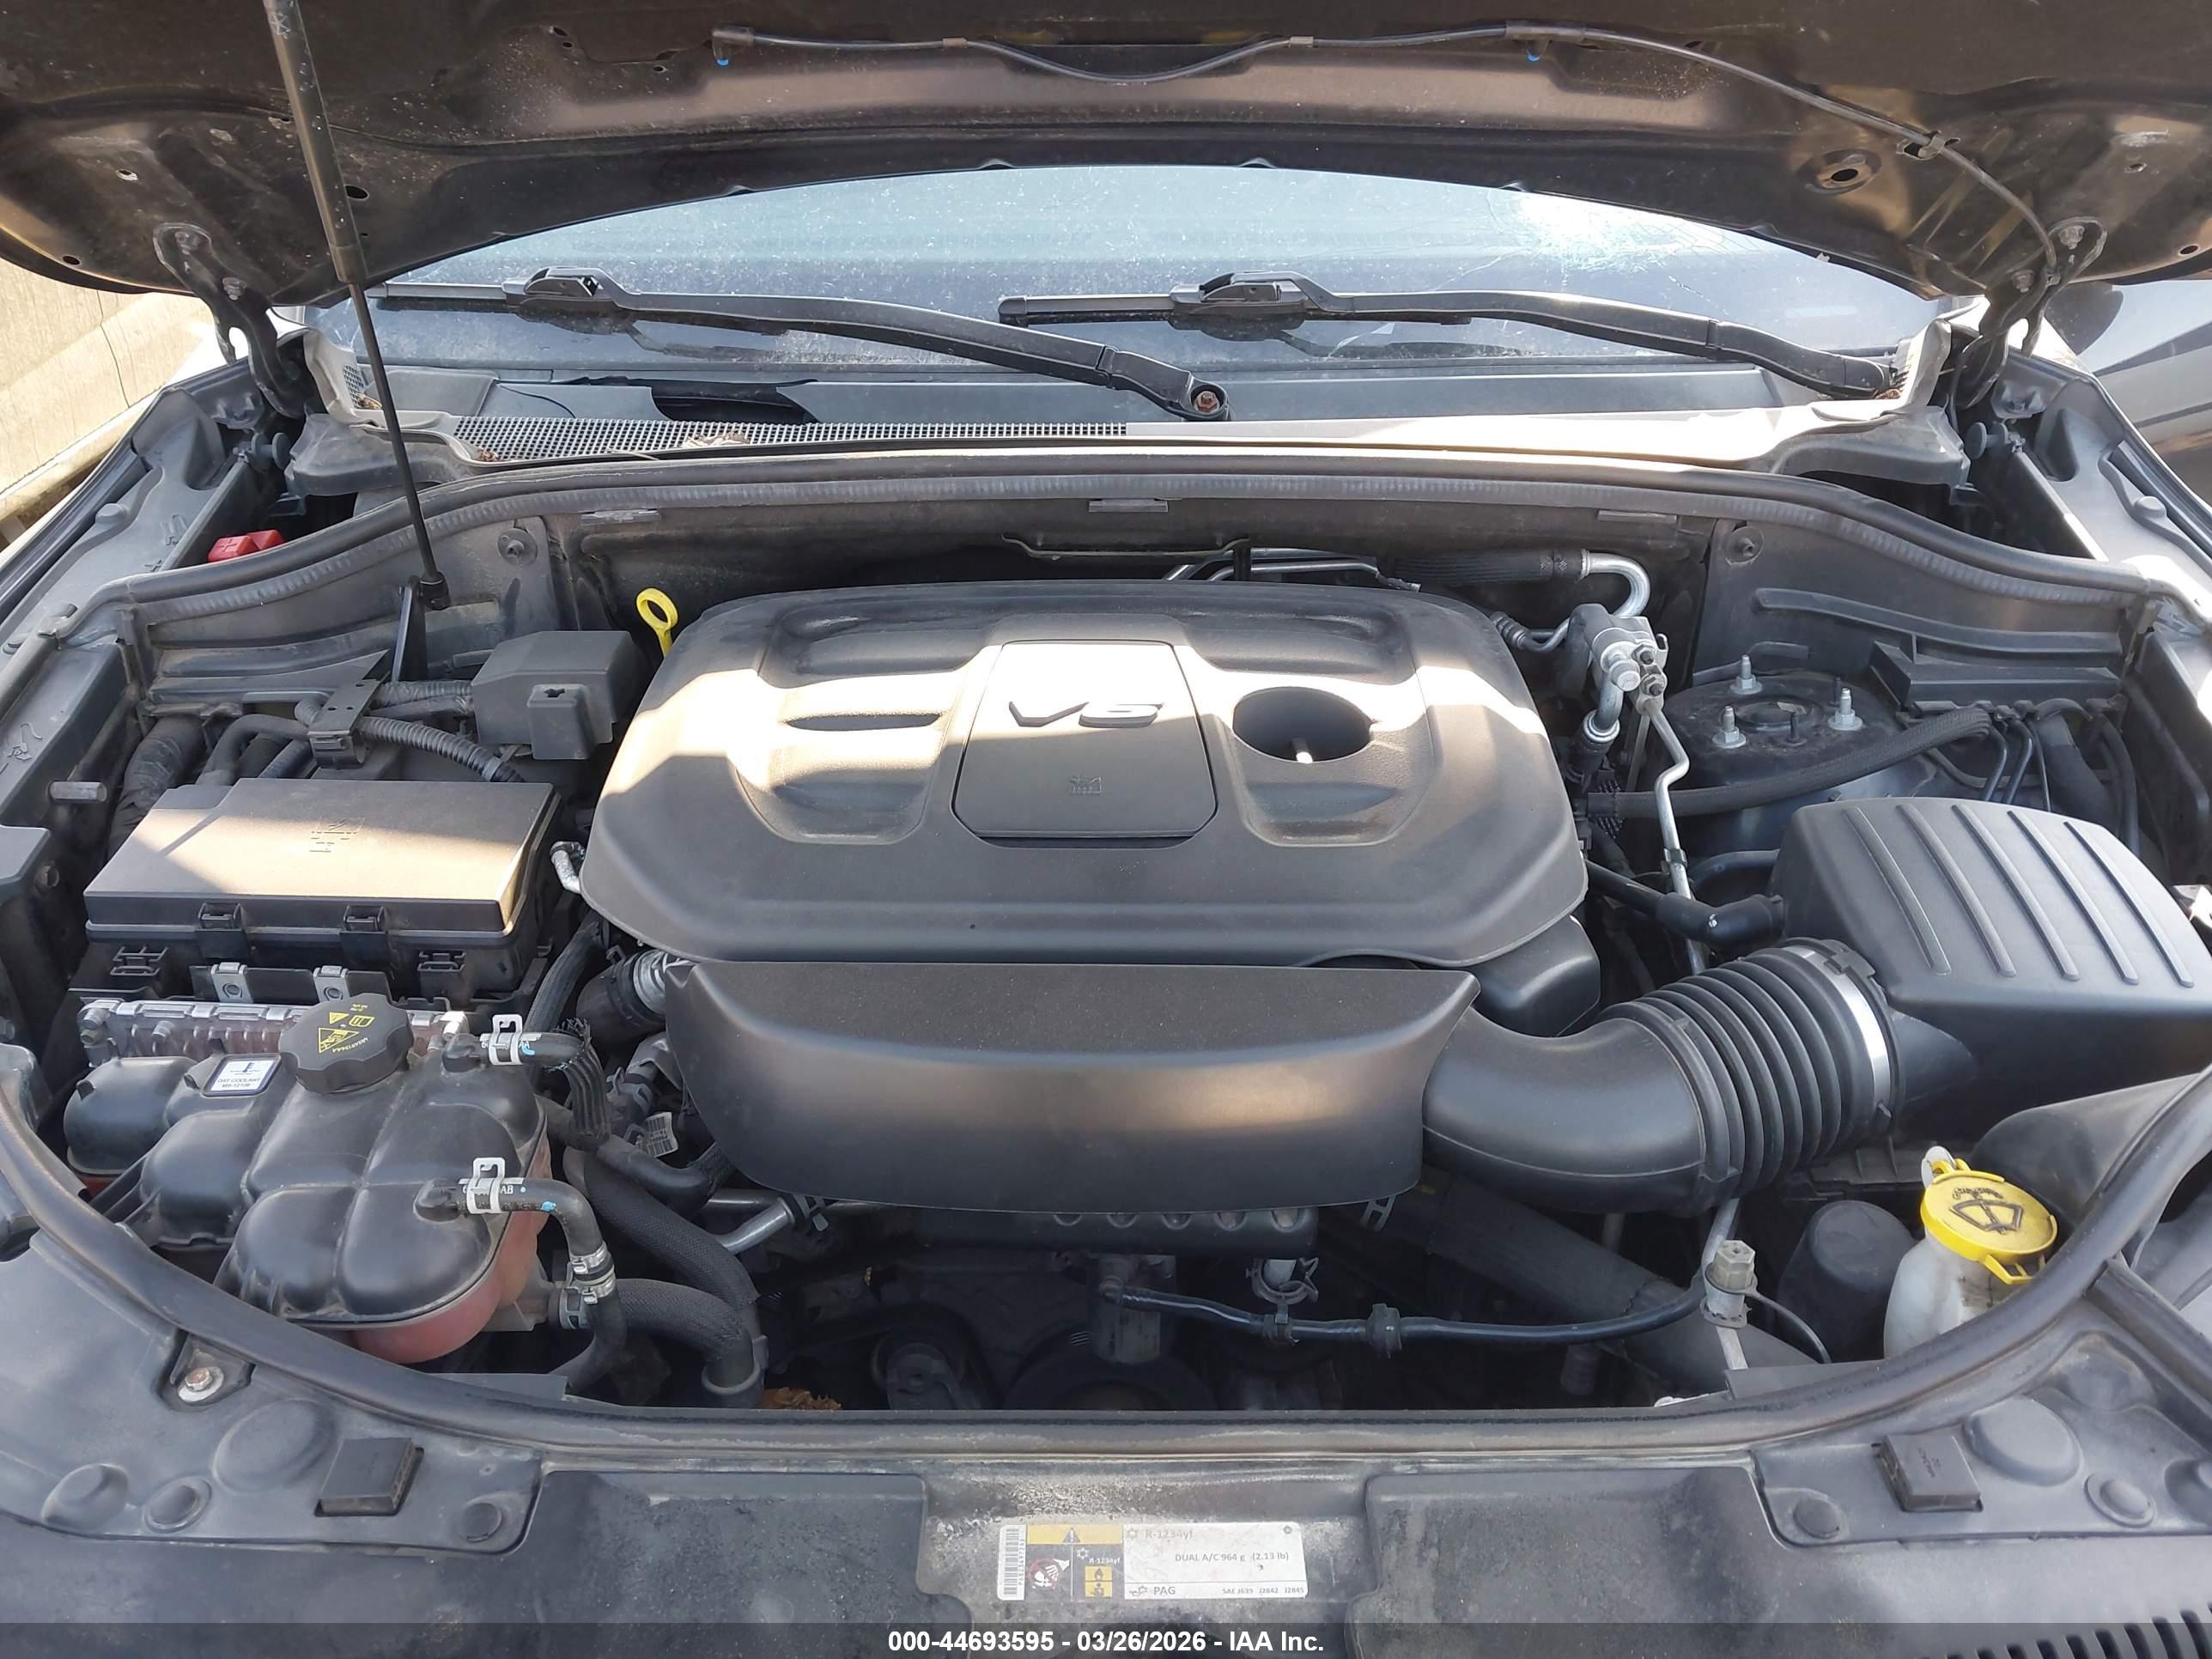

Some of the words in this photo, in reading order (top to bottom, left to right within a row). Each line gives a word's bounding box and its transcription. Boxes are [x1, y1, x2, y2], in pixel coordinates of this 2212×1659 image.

[1146, 1529, 1194, 1540] R-1234yf
[1175, 1553, 1200, 1562] DUAL
[1201, 1553, 1219, 1562] A/C
[1220, 1553, 1237, 1562] 964
[1252, 1552, 1275, 1562] (2.13
[1153, 1586, 1176, 1595] PAG
